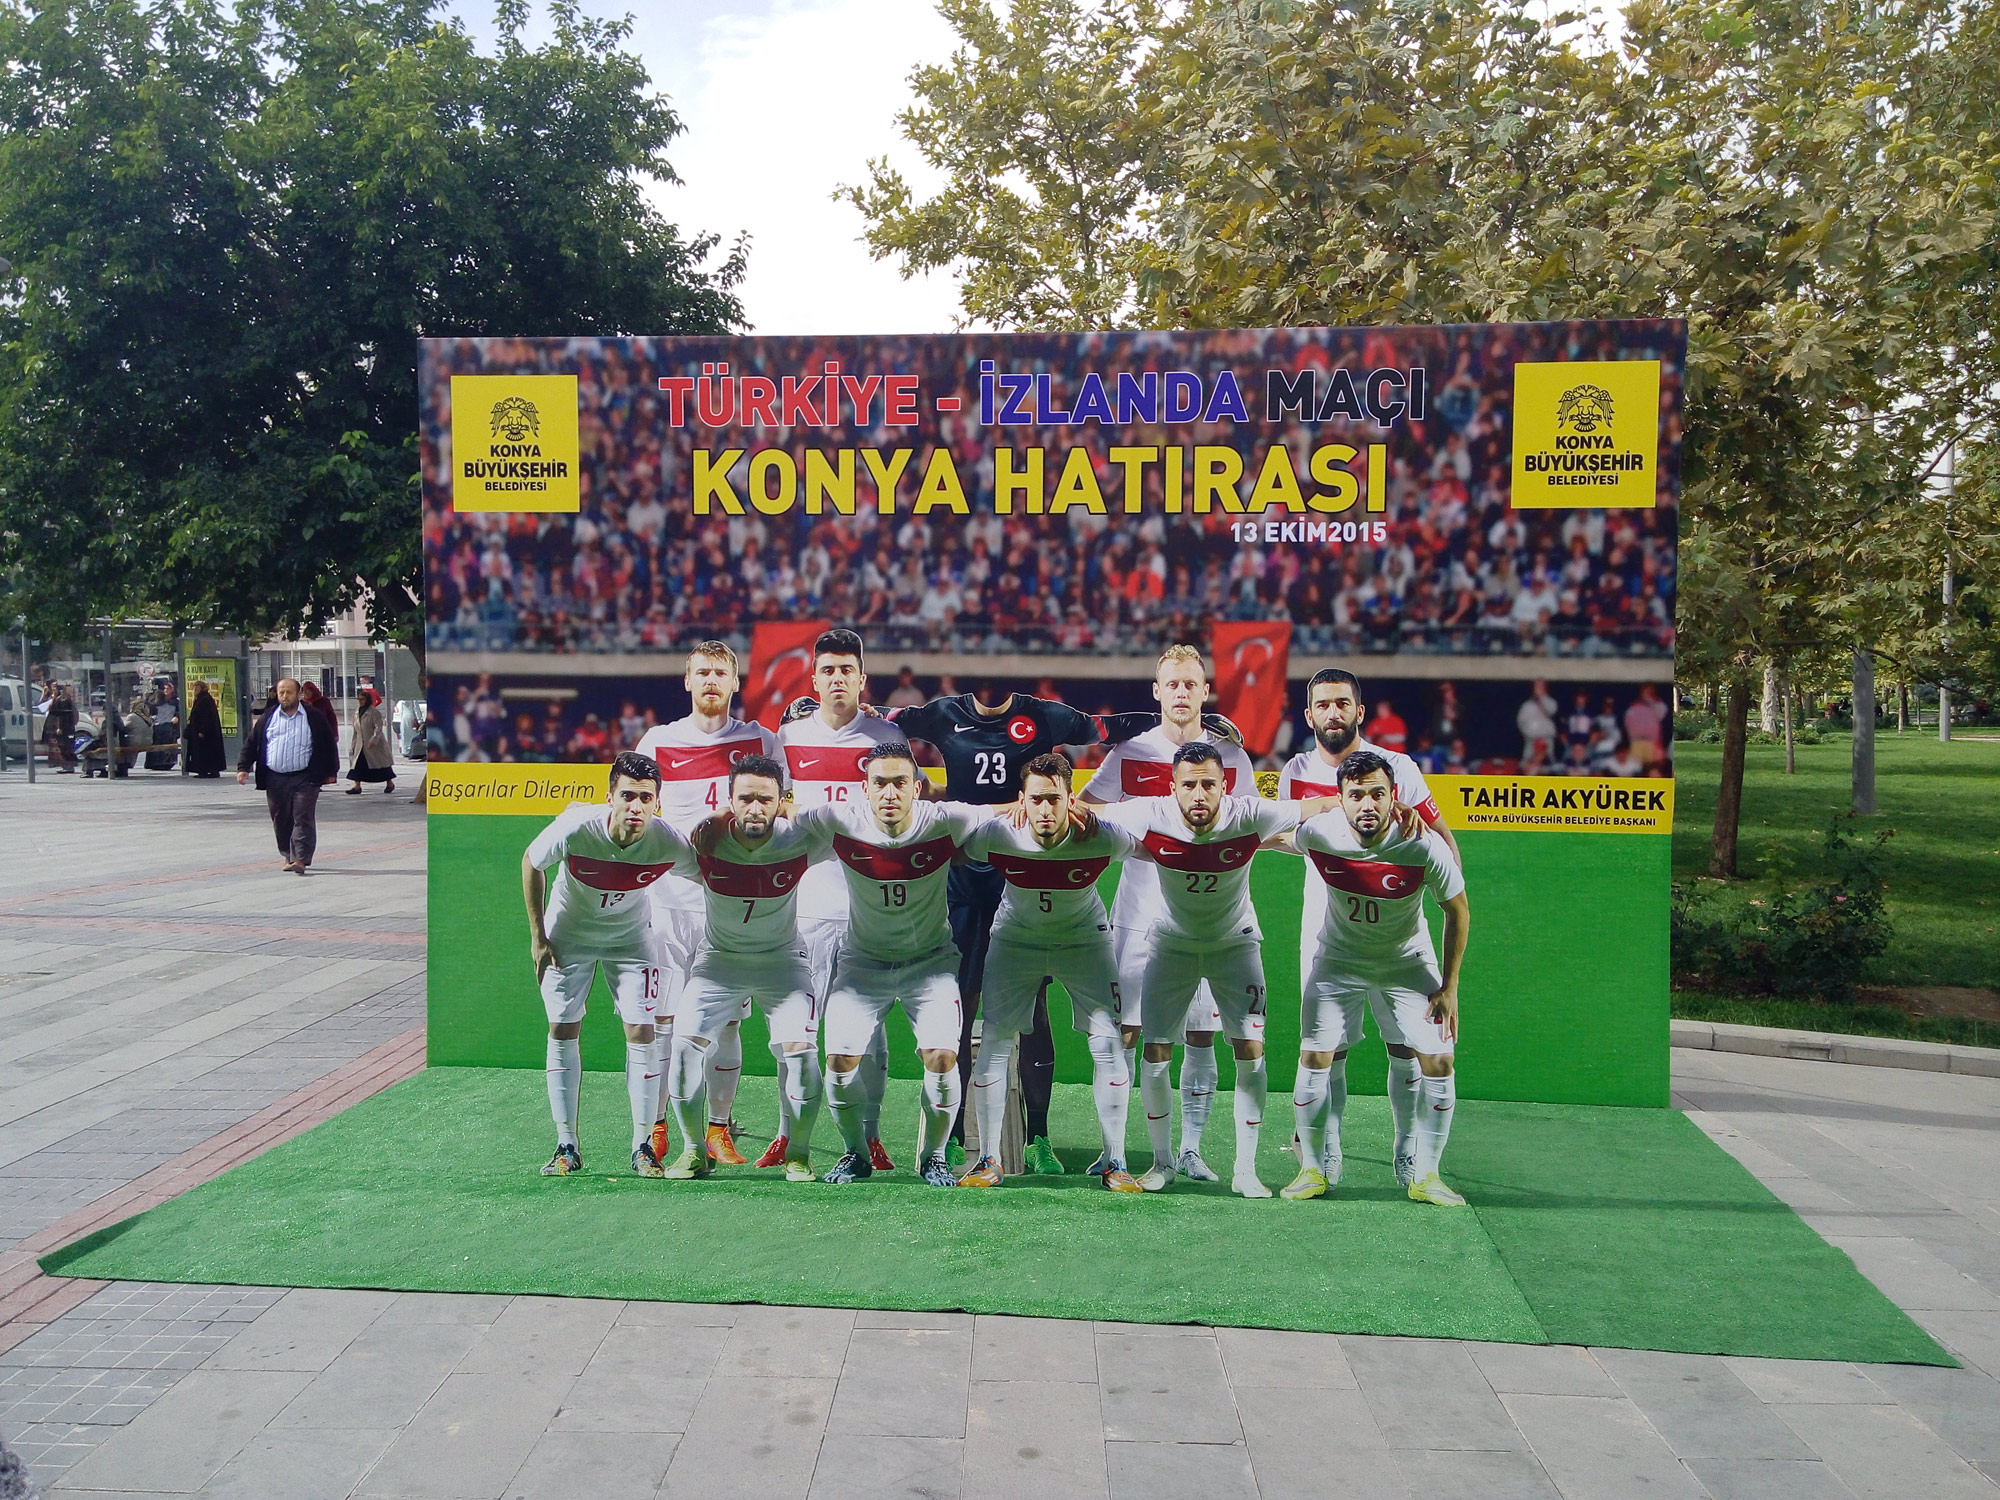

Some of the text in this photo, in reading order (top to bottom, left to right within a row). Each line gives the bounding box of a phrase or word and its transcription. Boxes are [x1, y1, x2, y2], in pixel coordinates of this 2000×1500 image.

[659, 360, 919, 427] TÜRKİYE
[980, 359, 1249, 425] İZLANDA
[1265, 367, 1426, 429] MAÇI
[490, 444, 541, 457] KONYA
[1556, 435, 1614, 449] KONYA
[464, 458, 567, 480] BÜYÜKŞEHİR
[1525, 450, 1643, 473] BÜYÜKŞEHİR
[485, 479, 547, 491] BELEDİYESİ
[692, 443, 1387, 515] KONYA HATIRASI
[1547, 472, 1619, 485] BELEDİYESİ
[1230, 516, 1387, 543] 13 EKİM2015
[974, 752, 1007, 785] 23
[429, 779, 595, 801] Başarılar Dilerim
[704, 782, 719, 811] 4
[1459, 783, 1666, 811] TAHİR AKYÜREK
[1467, 813, 1656, 827] KONYA BÜYÜKŞEHİR BELEDİYE BAŞKANI
[1186, 873, 1217, 893] 22
[880, 884, 907, 908] 19
[1039, 892, 1053, 913] 5
[743, 900, 755, 924] 7
[1347, 897, 1379, 924] 20
[641, 967, 659, 999] 13
[1110, 982, 1121, 1013] 5
